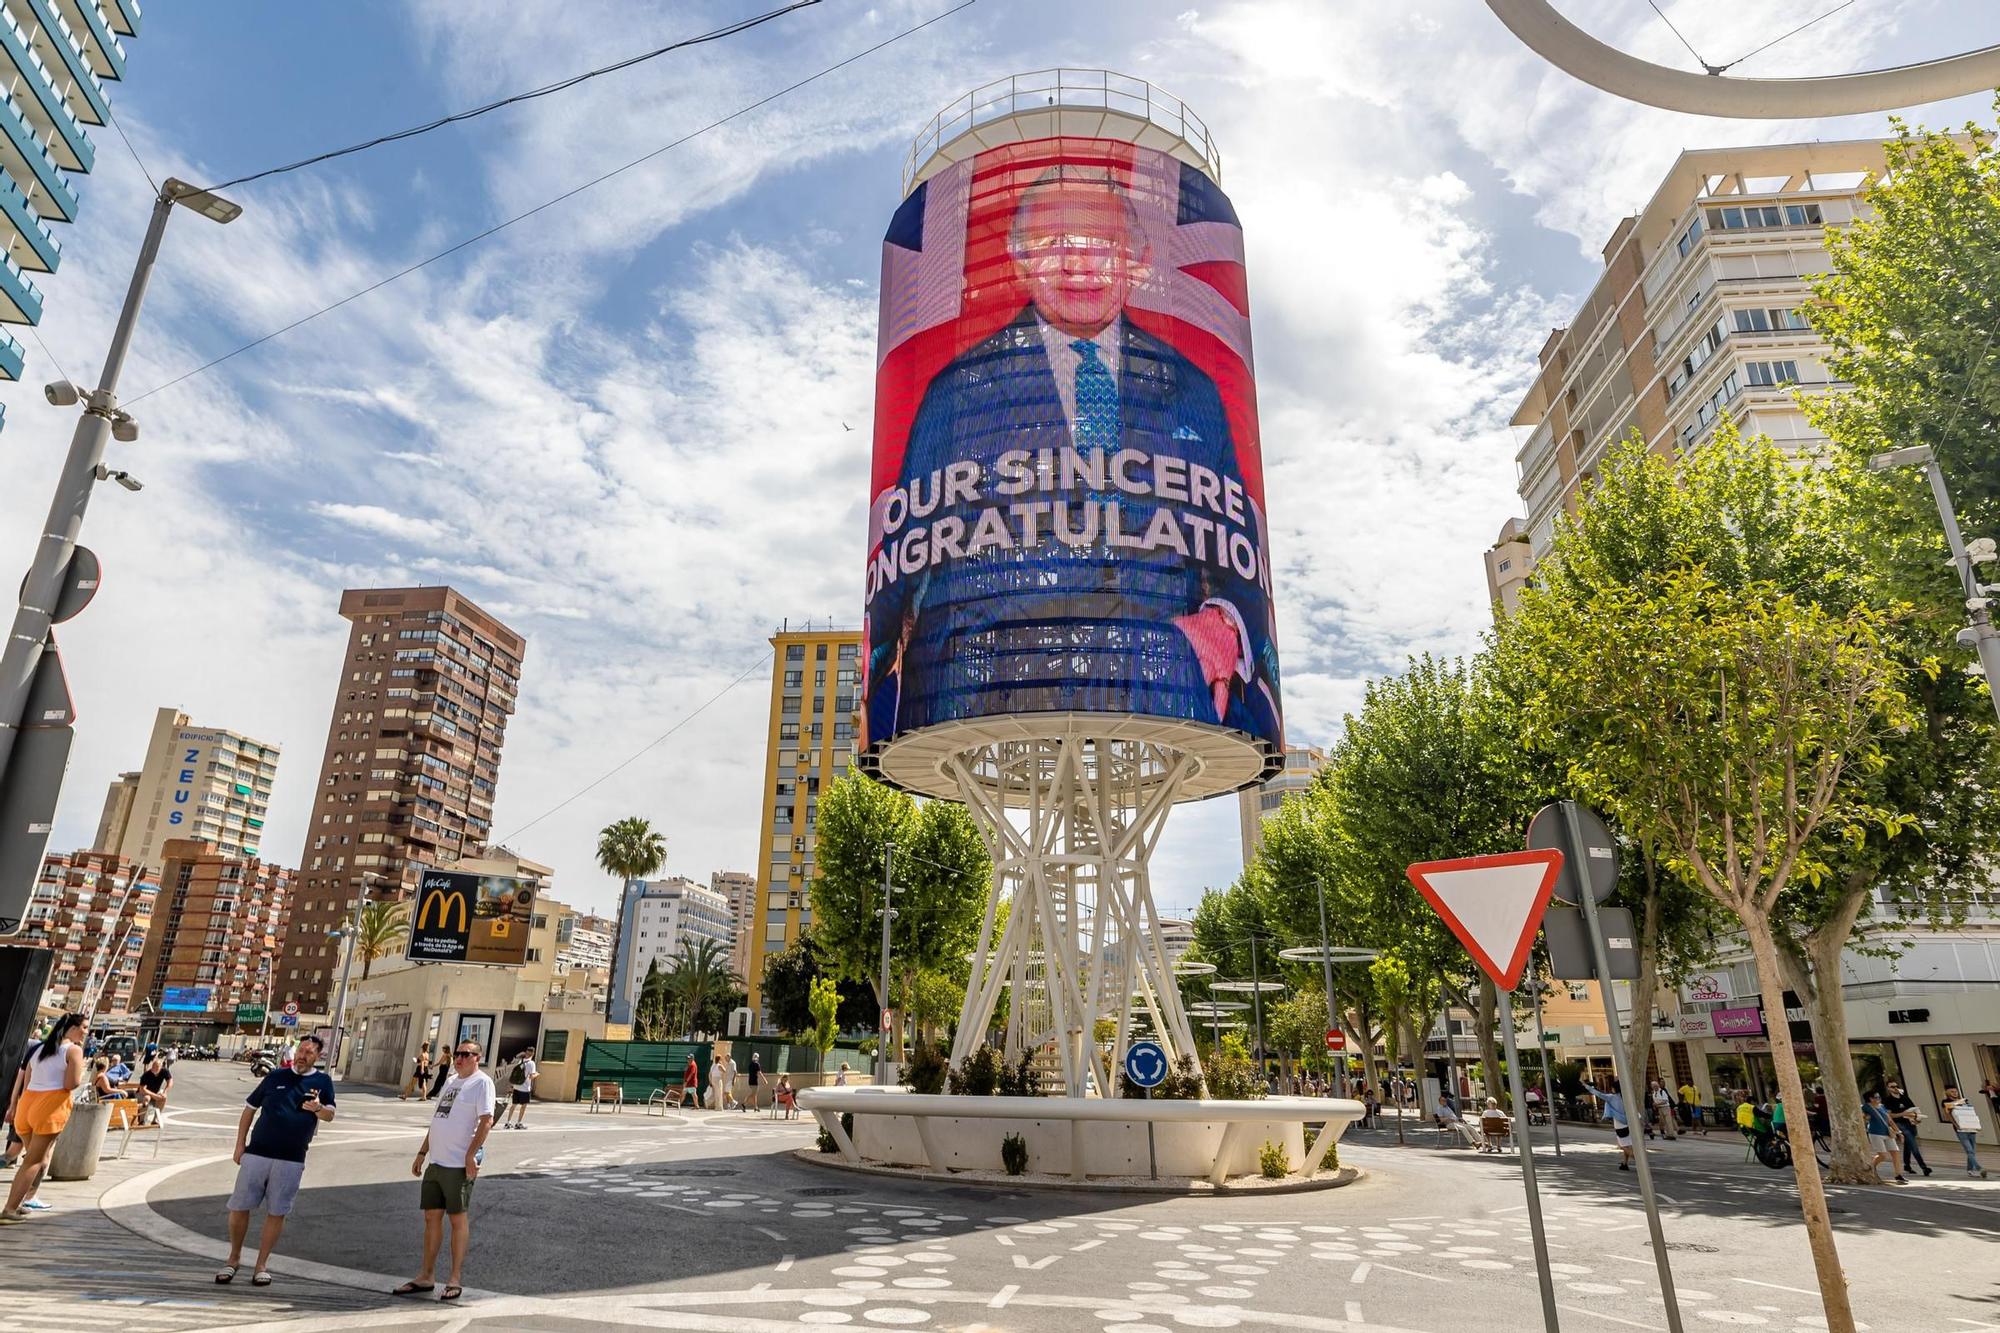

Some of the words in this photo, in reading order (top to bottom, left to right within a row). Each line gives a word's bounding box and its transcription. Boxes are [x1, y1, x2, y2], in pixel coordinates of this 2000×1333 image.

[882, 460, 982, 535] OUR
[995, 446, 1246, 527] SINCERE
[179, 733, 214, 742] EDIFICIO
[169, 749, 200, 824] ZEUS
[425, 879, 450, 889] McCafé
[1692, 992, 1727, 1000] doria
